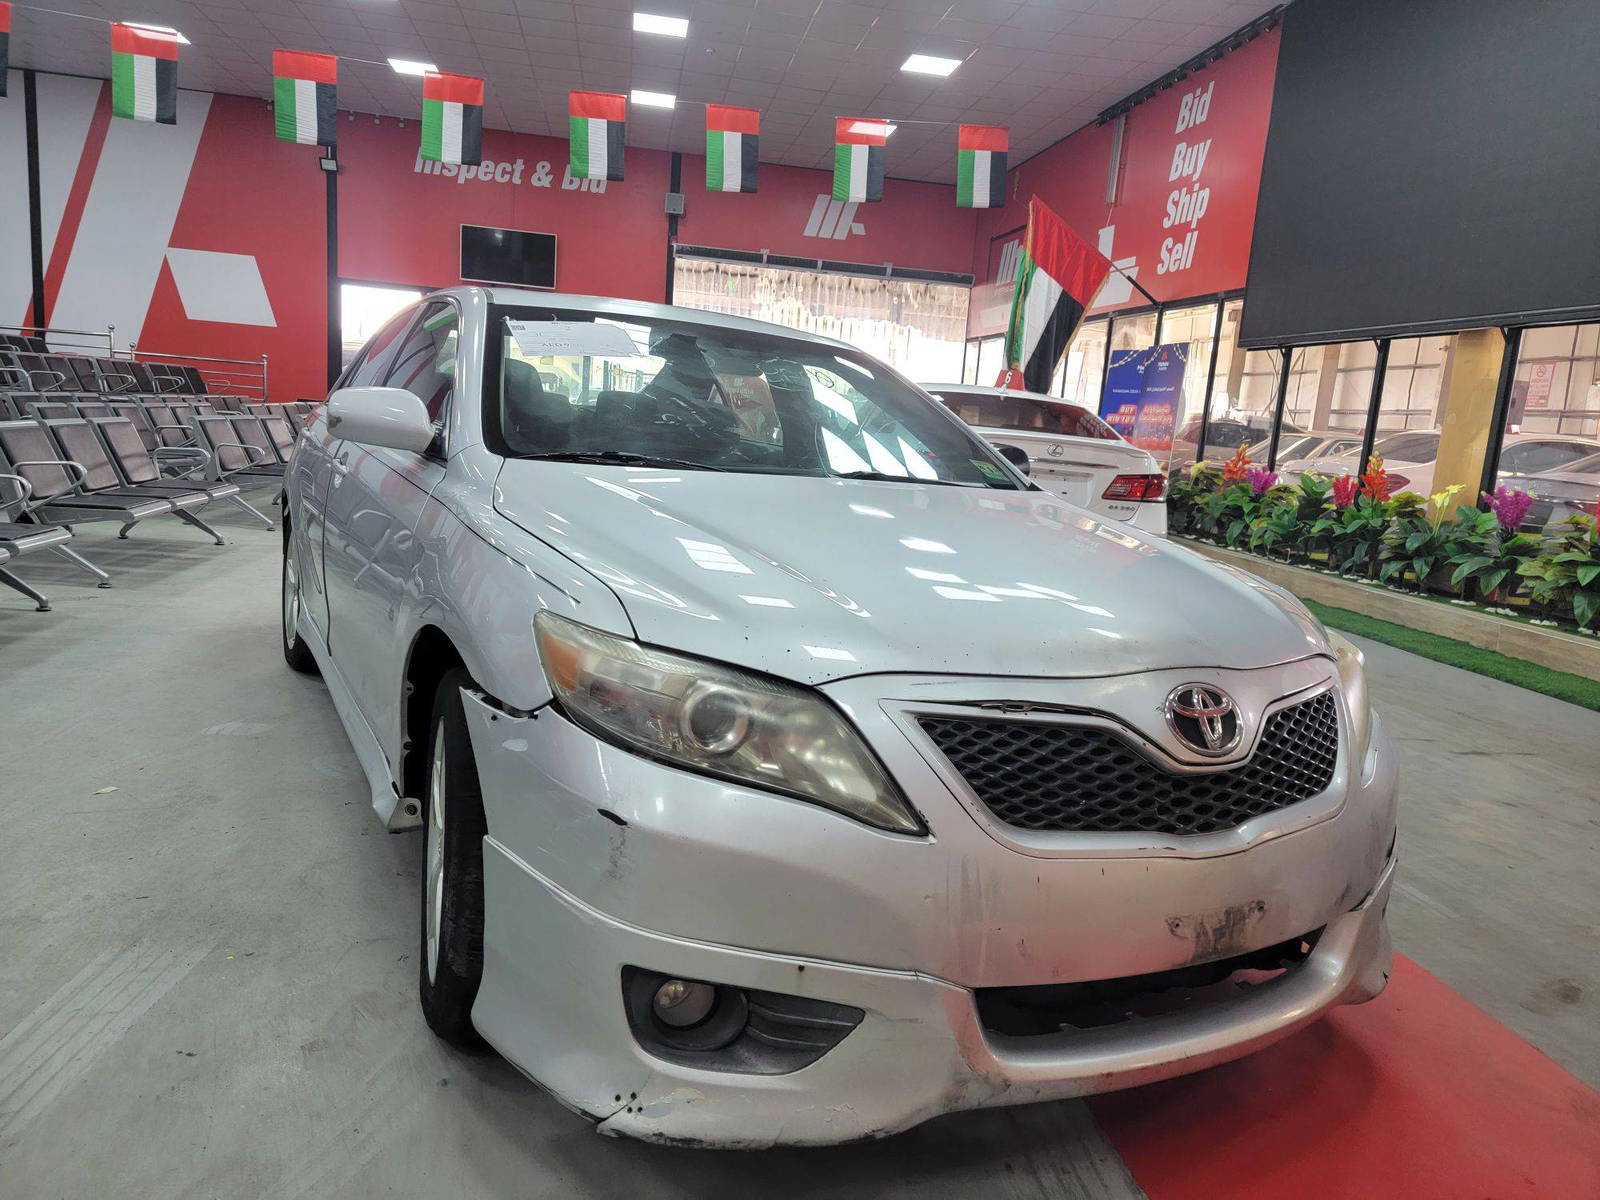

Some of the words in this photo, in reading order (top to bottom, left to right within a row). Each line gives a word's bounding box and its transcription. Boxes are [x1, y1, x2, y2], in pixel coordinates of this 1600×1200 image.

[1175, 81, 1215, 134] Bid
[530, 160, 553, 187] &
[1168, 139, 1212, 182] Buy
[1162, 183, 1210, 229] Ship
[1157, 231, 1198, 275] Sell
[1005, 371, 1012, 384] 6
